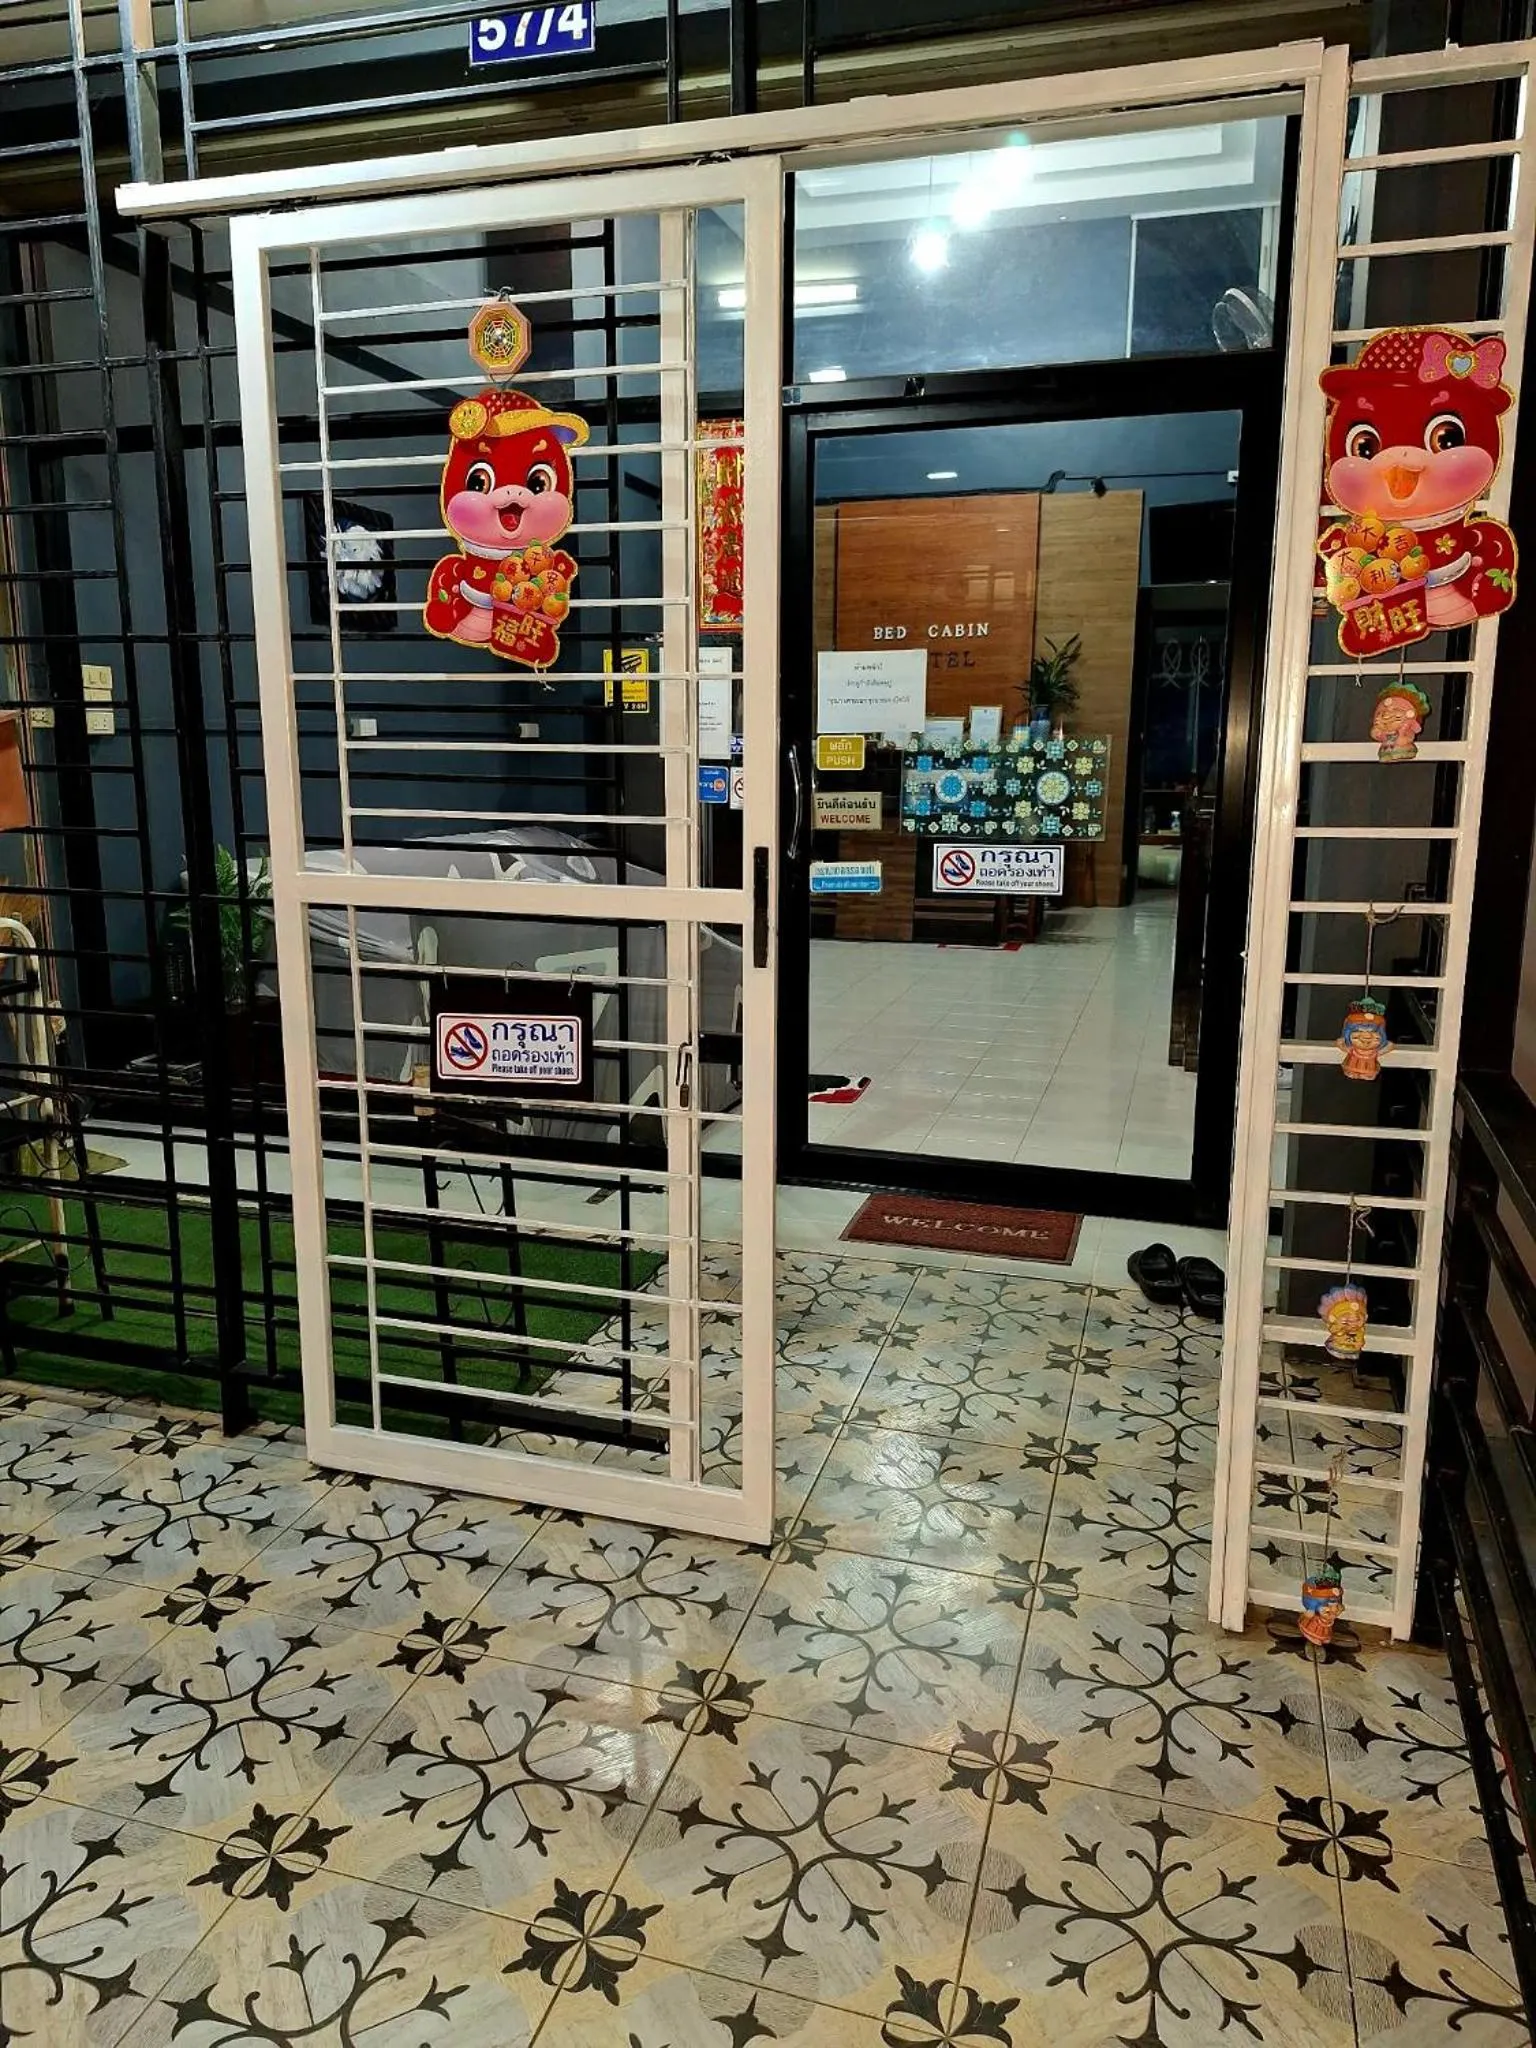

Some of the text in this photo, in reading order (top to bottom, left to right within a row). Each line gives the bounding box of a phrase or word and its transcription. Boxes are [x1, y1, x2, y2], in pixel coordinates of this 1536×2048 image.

[873, 622, 989, 640] BED CABIN
[826, 756, 856, 766] PUSH
[820, 814, 871, 824] WELCOME
[981, 850, 1054, 868] กรุณา
[980, 865, 1055, 878] ถอดรองเท้า
[492, 1022, 574, 1048] กรุณา
[492, 1044, 574, 1064] ถอดรองเท้า
[883, 1215, 1049, 1240] WELCOME
